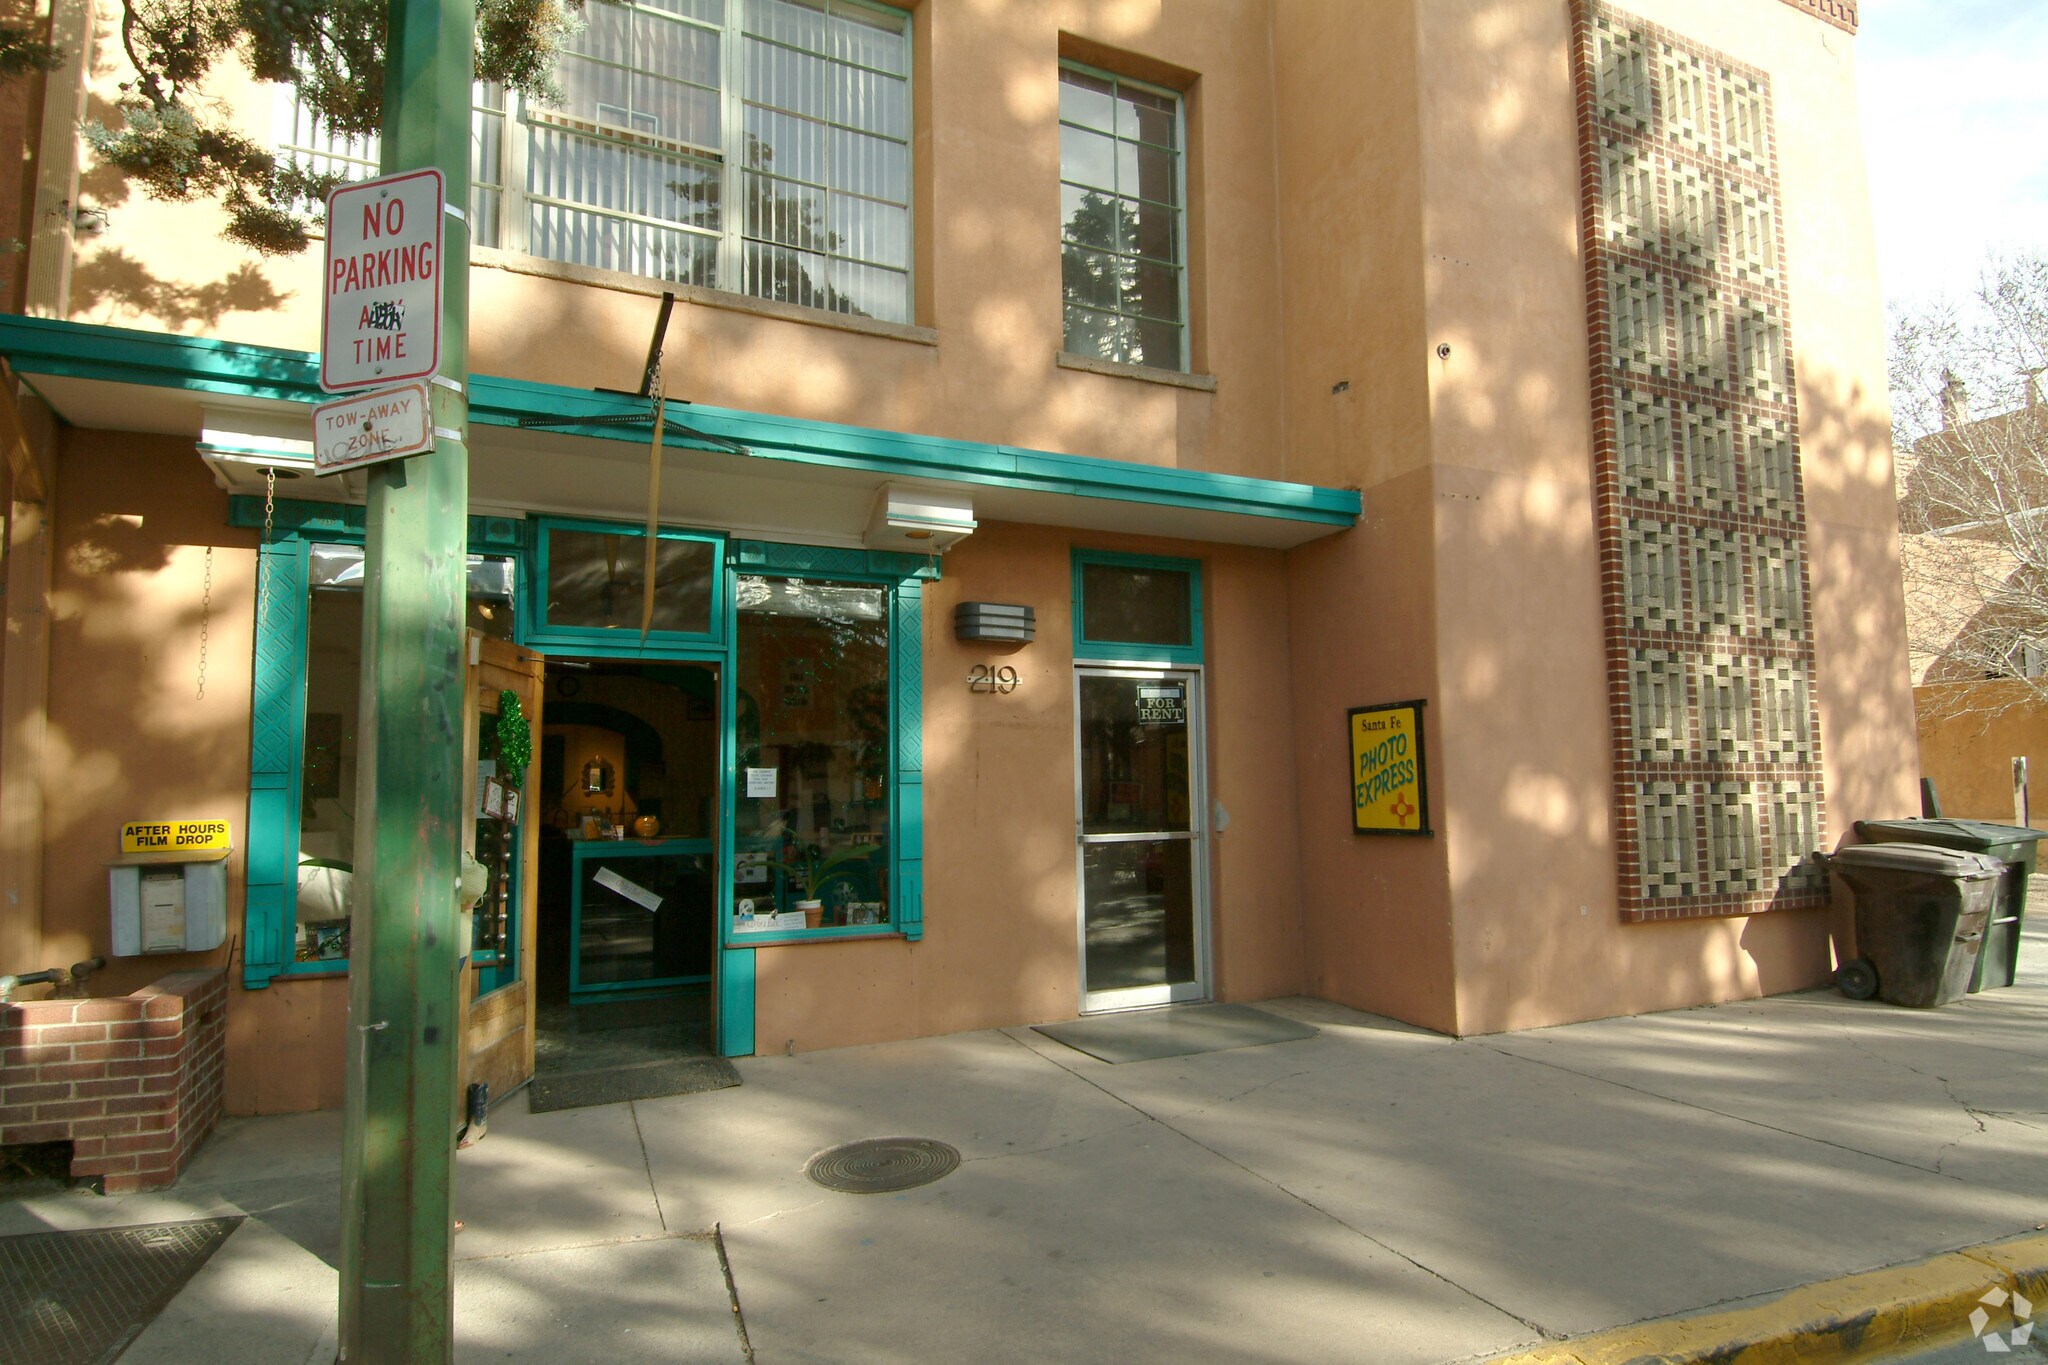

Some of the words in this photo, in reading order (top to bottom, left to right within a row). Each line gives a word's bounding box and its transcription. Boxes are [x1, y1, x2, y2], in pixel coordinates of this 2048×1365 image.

[363, 199, 404, 240] NO
[333, 242, 432, 294] PARKING
[354, 333, 407, 364] TIME
[326, 399, 411, 431] TOW-AWAY
[349, 429, 391, 451] ZONE
[970, 664, 1017, 694] 219
[1140, 708, 1182, 720] RENT
[1146, 698, 1175, 709] FOR
[1362, 719, 1386, 732] Santa
[1390, 716, 1401, 729] Fe
[1360, 733, 1407, 777] PHOTO
[1356, 759, 1415, 808] EXPRESS
[126, 825, 170, 836] AFTER
[179, 824, 225, 834] HOURS
[137, 837, 168, 846] FILM
[176, 835, 213, 844] DROP
